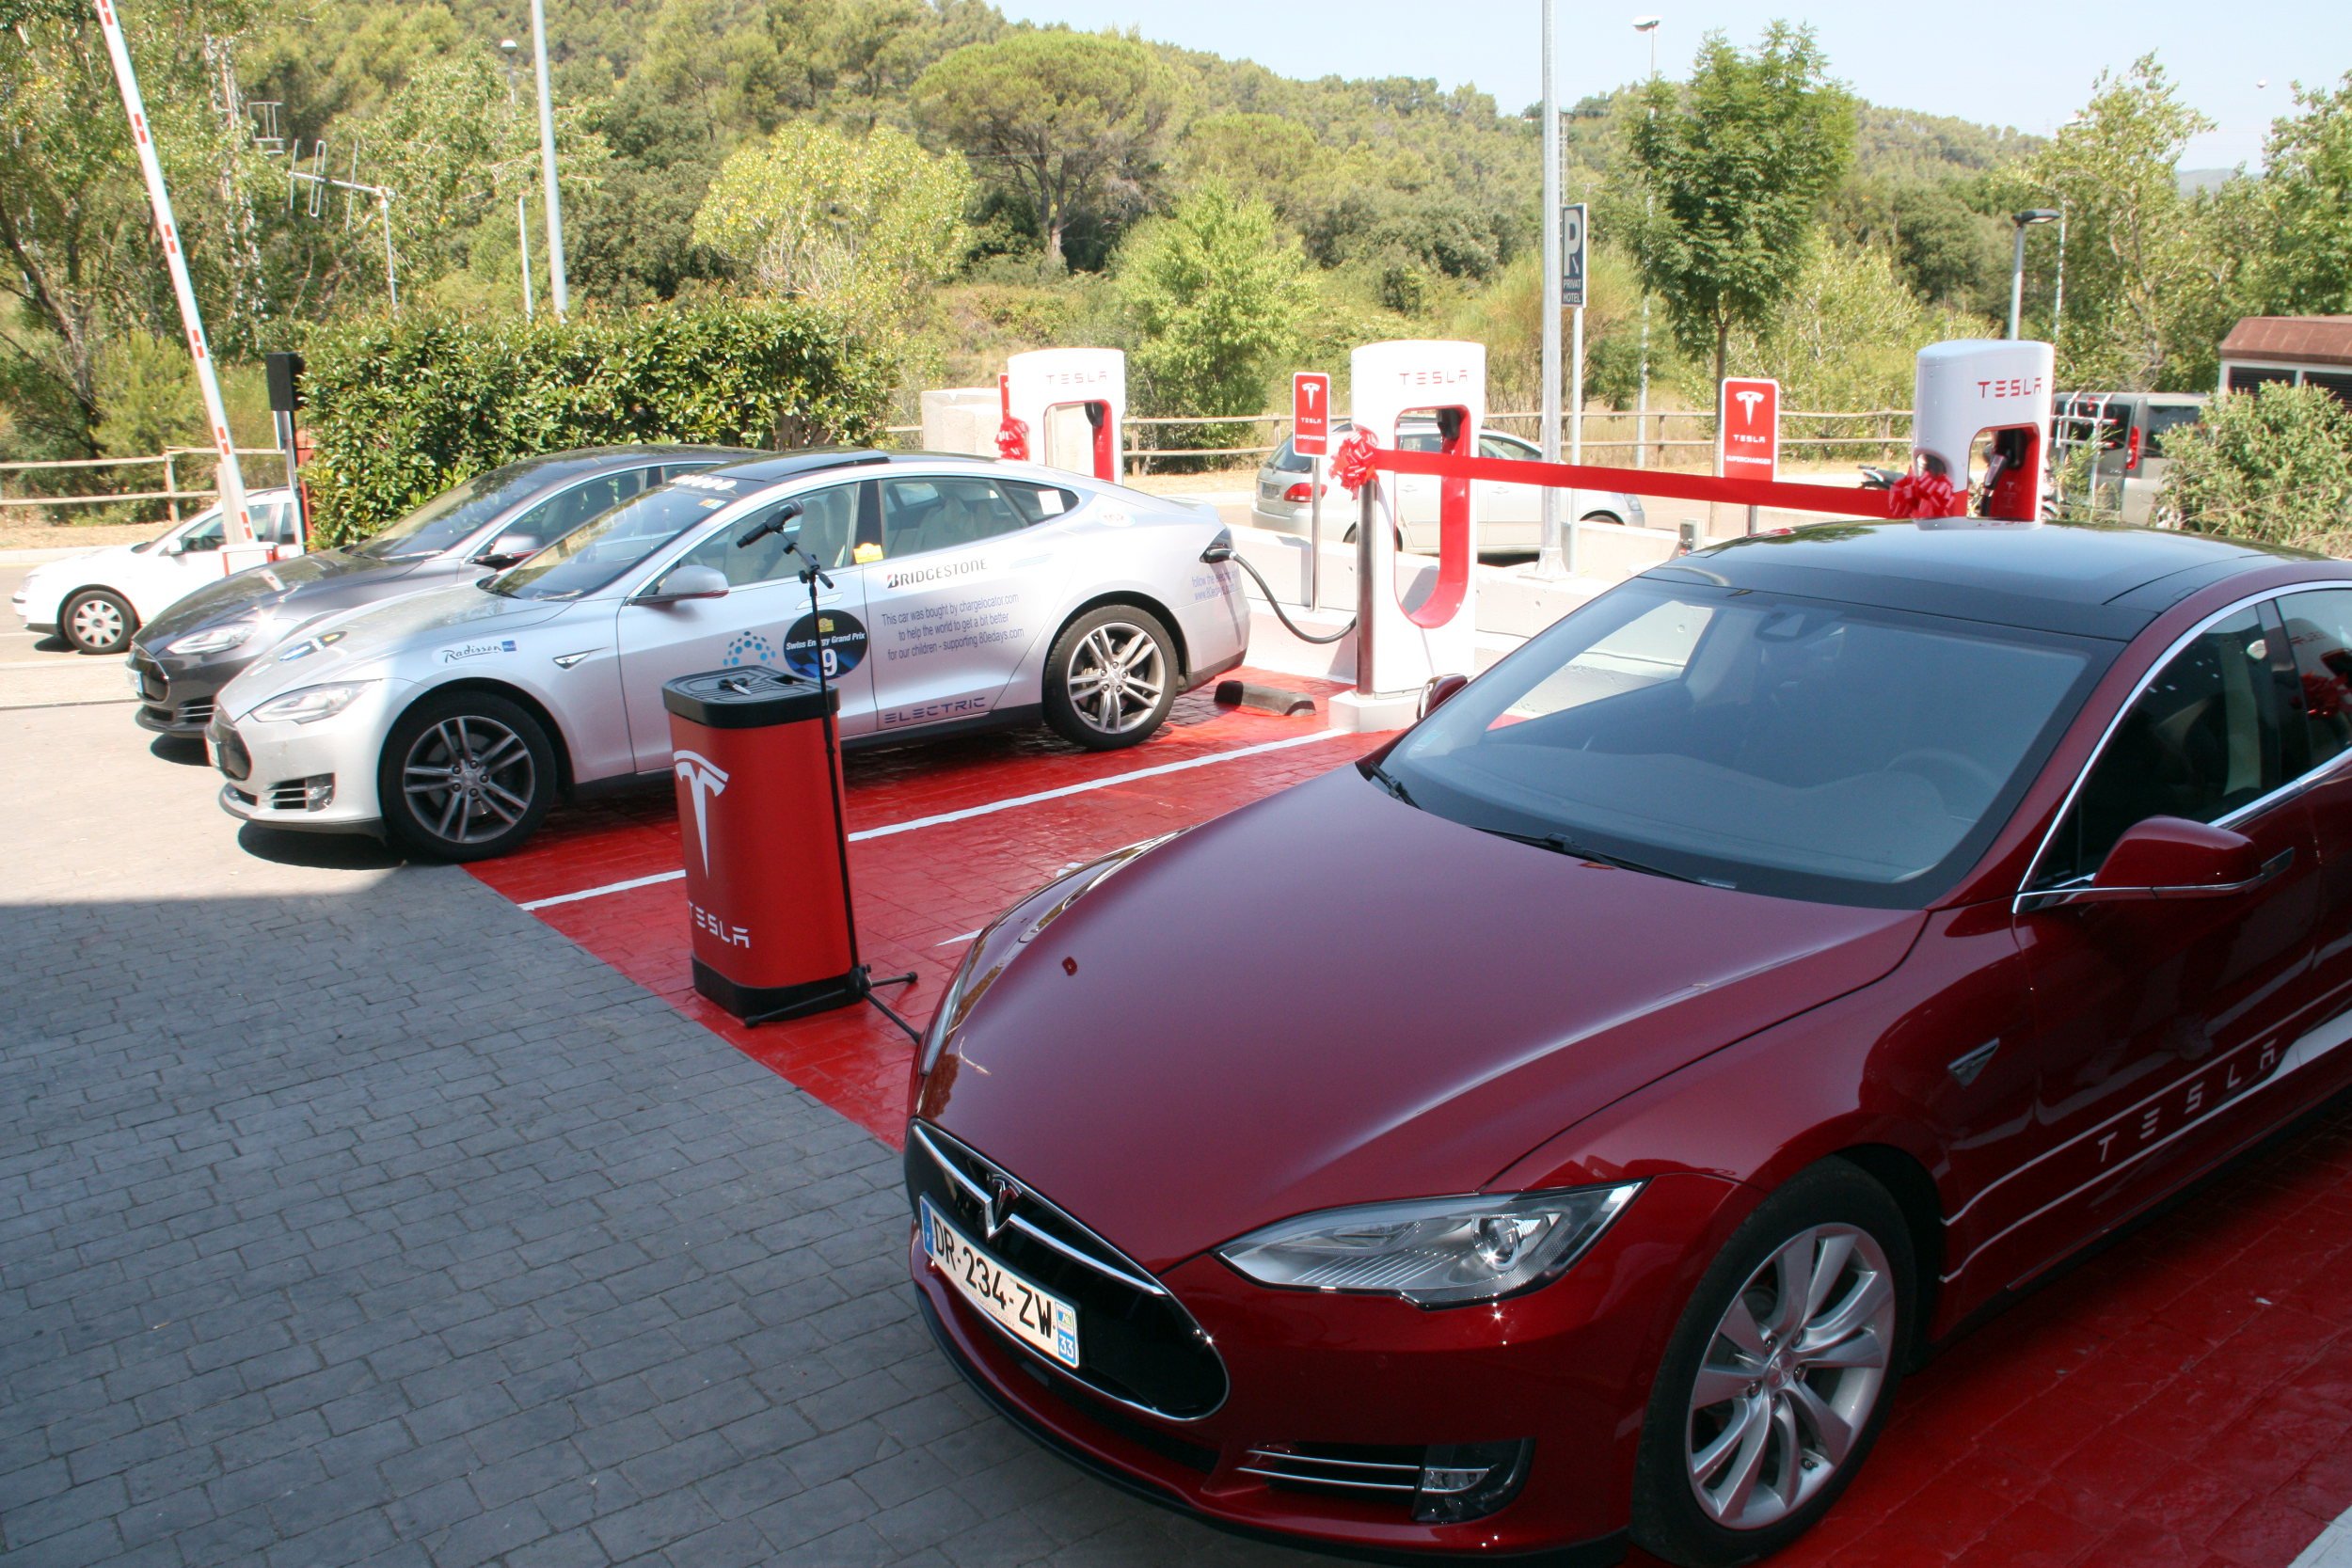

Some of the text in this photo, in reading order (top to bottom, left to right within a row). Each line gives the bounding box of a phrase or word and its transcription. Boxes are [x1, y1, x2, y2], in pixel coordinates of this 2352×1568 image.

[1564, 209, 1581, 277] P
[1564, 279, 1581, 290] PRIVAT
[1564, 293, 1581, 303] HOTEL
[1046, 371, 1107, 385] TESLA
[1399, 370, 1468, 385] TESLA
[1977, 377, 2042, 398] TESLA
[1733, 435, 1766, 443] TESLA
[1725, 455, 1772, 465] SUPERCHARGER
[887, 559, 987, 589] BRIDGESTONE
[882, 594, 1019, 626] This car was bought by chargelocator.com
[898, 630, 906, 641] to
[907, 626, 921, 641] help
[923, 626, 933, 637] the
[935, 622, 952, 634] world
[954, 621, 961, 631] to
[961, 619, 973, 632] get
[974, 618, 979, 628] a
[990, 611, 1009, 625] better
[442, 644, 501, 663] Radisson
[786, 631, 866, 651] Swiss Engy Grand Prix
[887, 649, 898, 661] for
[898, 647, 910, 659] our
[912, 642, 937, 657] children
[943, 635, 978, 651] supporting
[978, 626, 1025, 646] 80edays.com
[822, 648, 837, 676] 9
[884, 697, 985, 723] ELECTRIC
[688, 900, 750, 948] TESLA
[2098, 1038, 2277, 1163] TESLA
[933, 1213, 1052, 1338] DR-234-ZW
[1058, 1334, 1074, 1358] 33
